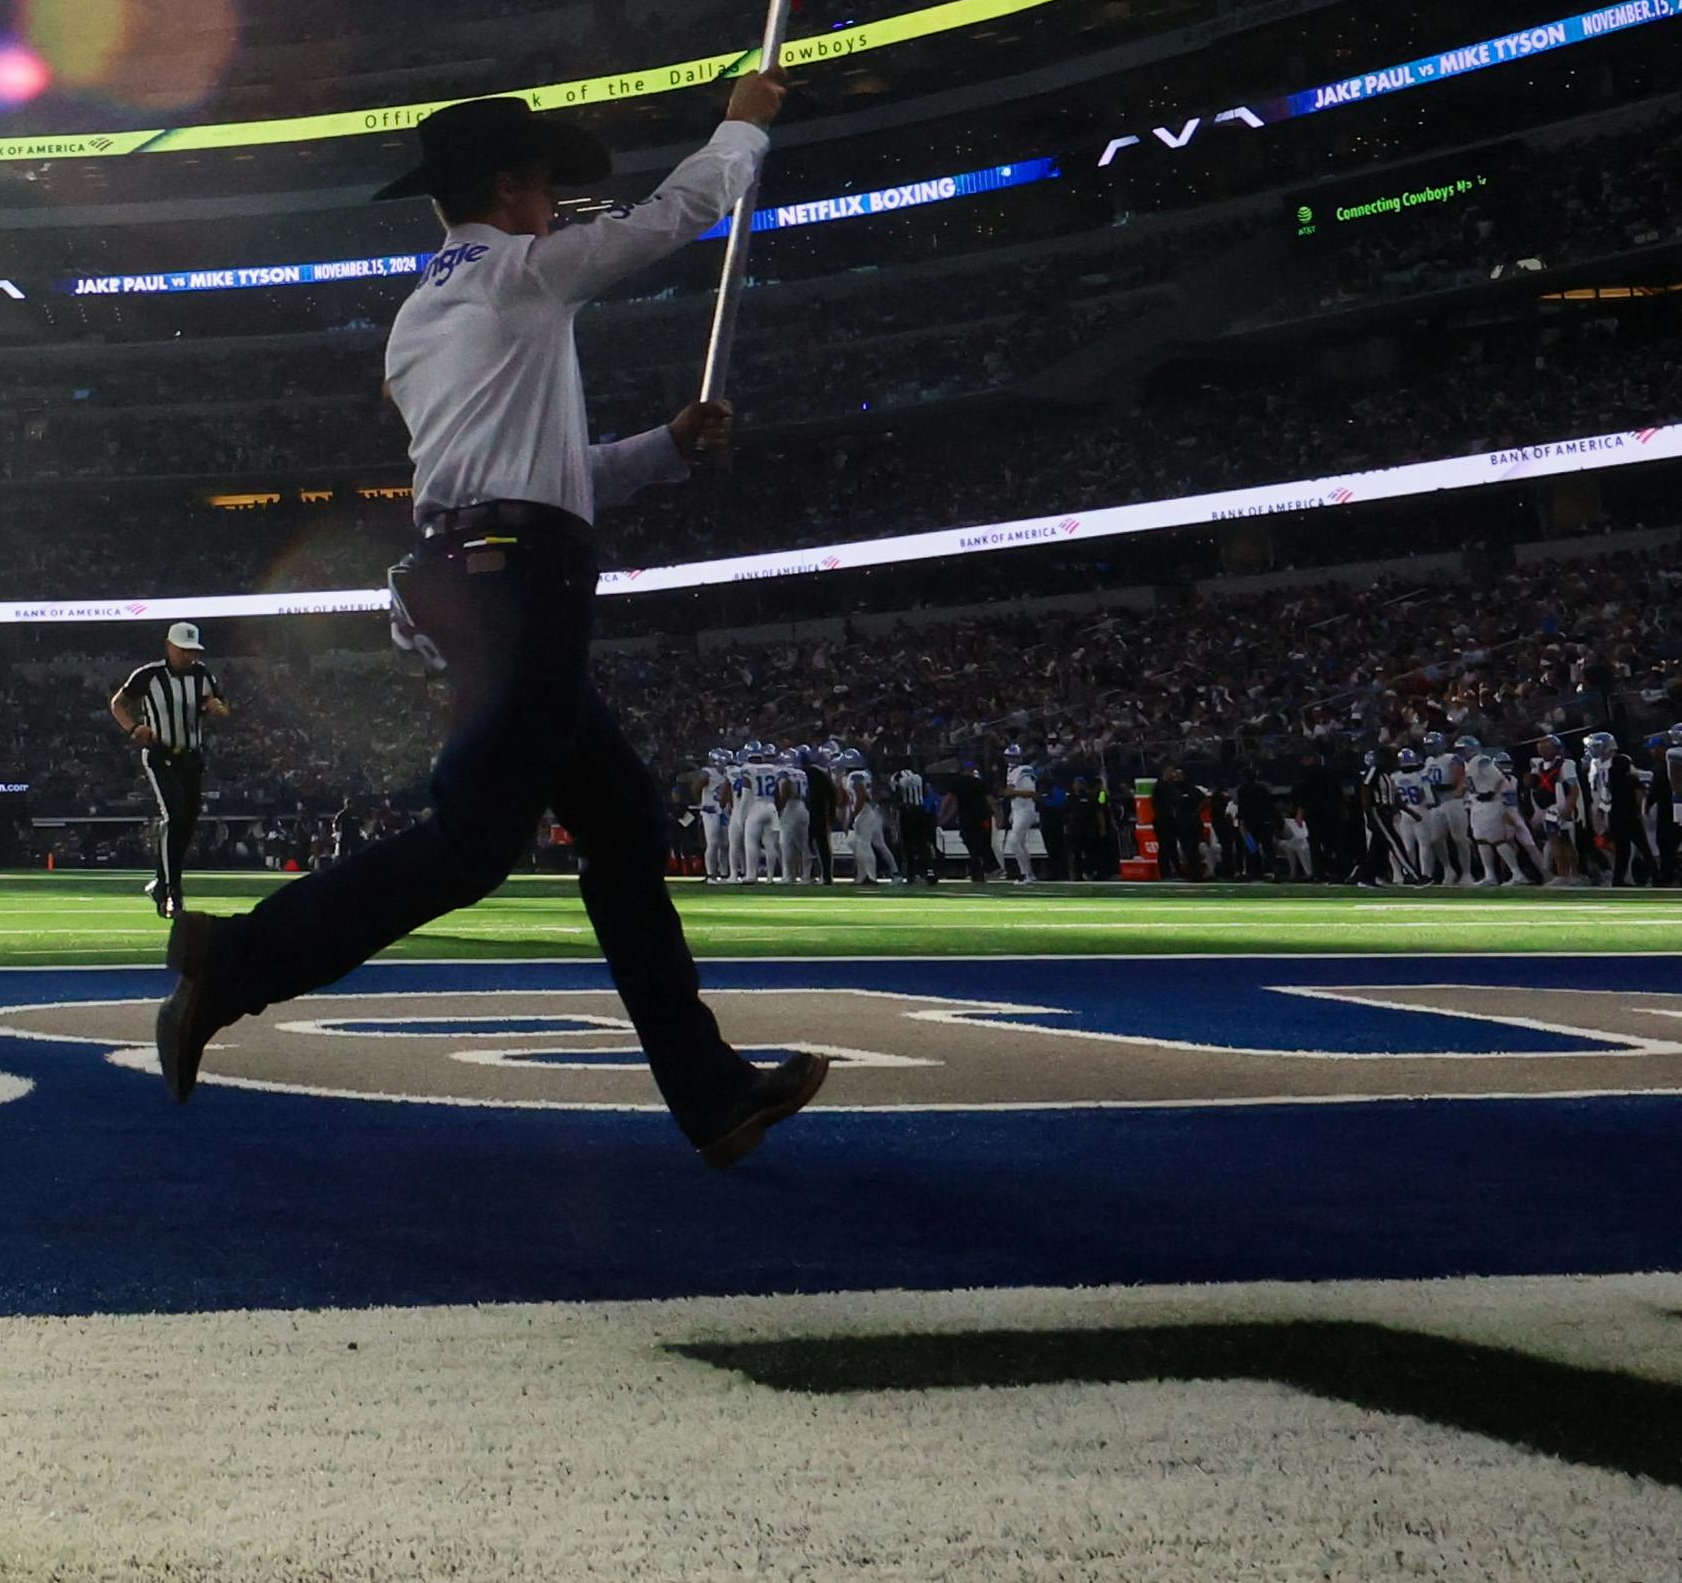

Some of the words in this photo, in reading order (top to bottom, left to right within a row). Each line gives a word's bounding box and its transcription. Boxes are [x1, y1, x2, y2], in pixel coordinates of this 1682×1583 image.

[566, 84, 588, 103] of
[608, 78, 645, 97] the
[784, 31, 869, 63] owboys
[1314, 79, 1362, 109] JAKE
[1365, 65, 1416, 94] PAUL
[1418, 63, 1434, 78] vs
[1439, 44, 1492, 75] MIKE
[1494, 22, 1567, 61] TYSON
[7, 145, 24, 156] OF
[26, 143, 86, 155] AMERICA
[777, 195, 865, 227] NETFLIX
[869, 177, 957, 213] BOXING
[1337, 195, 1401, 221] Connecting
[1402, 185, 1455, 206] Cowboys
[75, 274, 121, 295] JAKE
[123, 272, 168, 291] PAUL
[172, 276, 186, 287] vs
[189, 270, 234, 288] MIKE
[237, 266, 301, 286] TYSON
[389, 256, 417, 274] 2024
[1491, 448, 1530, 466] BANK
[1533, 447, 1551, 459] OF
[1554, 436, 1624, 457] AMERICA
[1212, 509, 1246, 521] BANK
[1248, 507, 1264, 516] OF
[1266, 498, 1325, 514] AMERICA
[960, 536, 989, 548] BANK
[990, 534, 1005, 544] OF
[1007, 527, 1058, 543] AMERICA
[14, 609, 47, 618] BANK
[50, 608, 65, 617] OF
[67, 607, 122, 617] AMERICA
